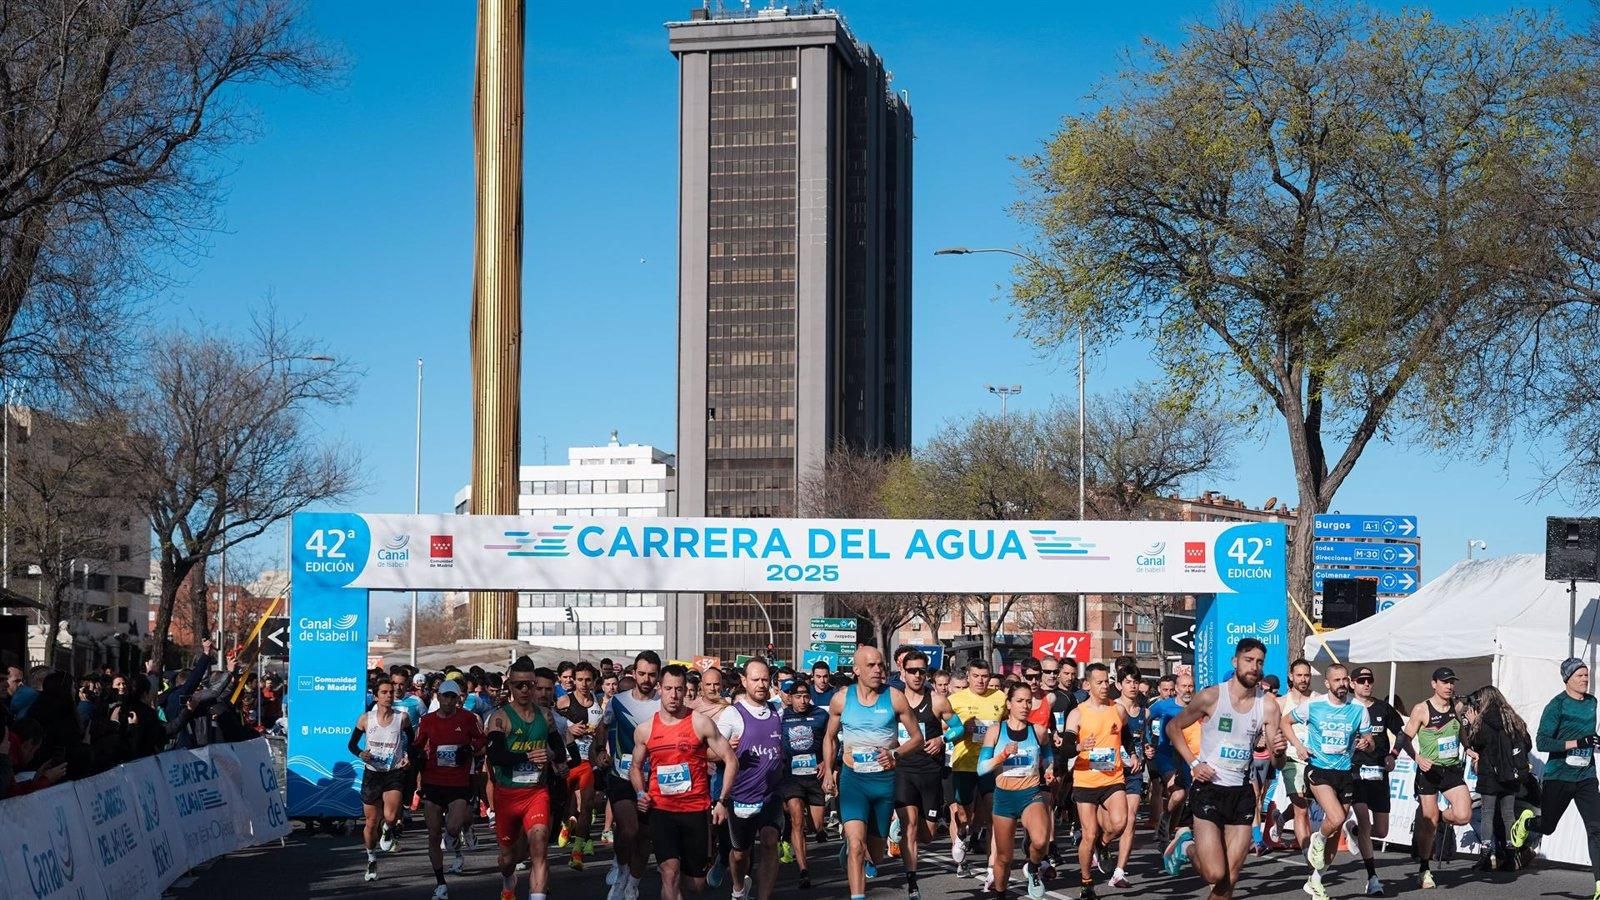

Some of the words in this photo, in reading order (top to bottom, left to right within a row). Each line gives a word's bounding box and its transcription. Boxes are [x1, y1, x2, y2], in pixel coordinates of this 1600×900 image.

[1315, 521, 1351, 532] Burgos
[577, 525, 793, 559] CARRERA
[808, 528, 891, 560] DEL
[904, 529, 1028, 560] AGUA
[377, 549, 409, 560] Canal
[1136, 555, 1165, 566] Canal
[305, 561, 354, 572] EDICIÓN
[766, 564, 839, 582] 2025
[1228, 567, 1272, 579] EDICIÓN
[300, 618, 332, 630] Canal
[1227, 623, 1256, 633] Canal
[300, 631, 314, 642] de
[317, 631, 349, 642] Isabel
[1227, 634, 1239, 645] de
[314, 676, 357, 684] Comunidad
[327, 683, 357, 691] Madrid
[313, 727, 352, 735] MADRID
[1319, 721, 1353, 731] 2025
[662, 773, 684, 783] 734
[22, 843, 63, 899] Canal
